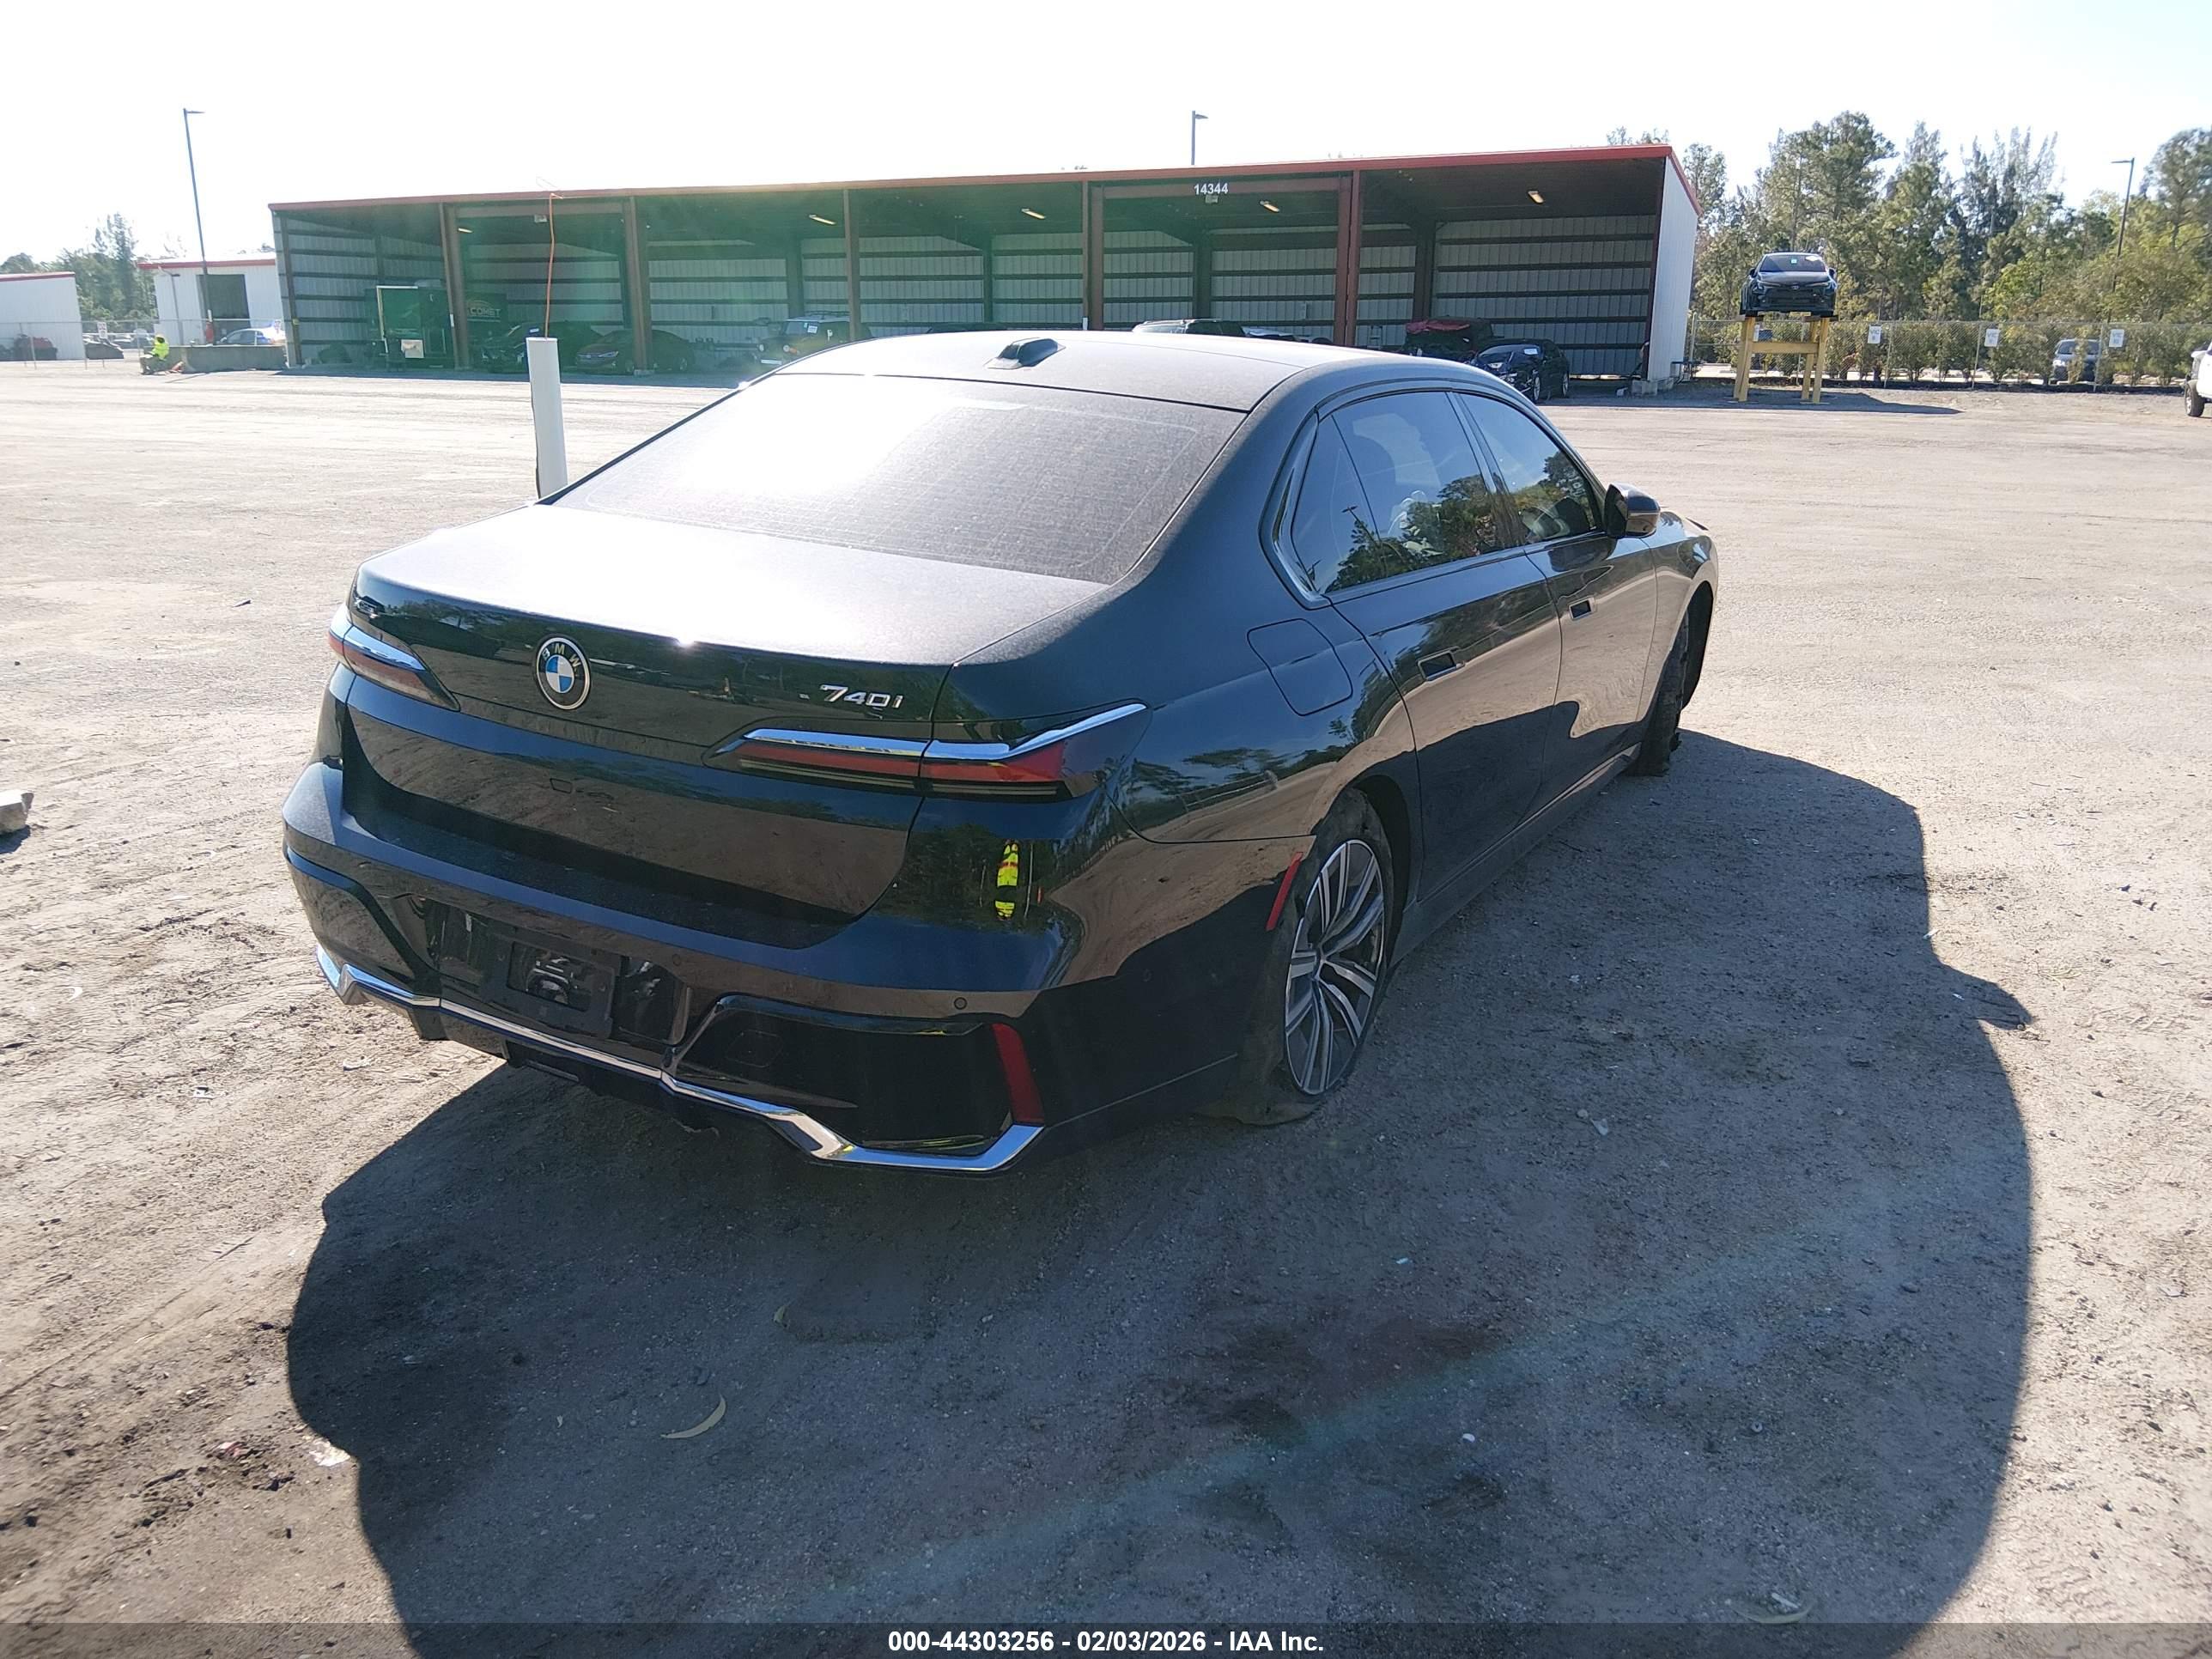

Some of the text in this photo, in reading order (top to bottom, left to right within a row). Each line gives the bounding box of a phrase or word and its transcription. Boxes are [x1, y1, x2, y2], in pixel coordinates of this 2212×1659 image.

[1194, 183, 1229, 195] 14344
[470, 307, 501, 317] COMET
[542, 643, 582, 668] BMW
[819, 684, 904, 708] 740i
